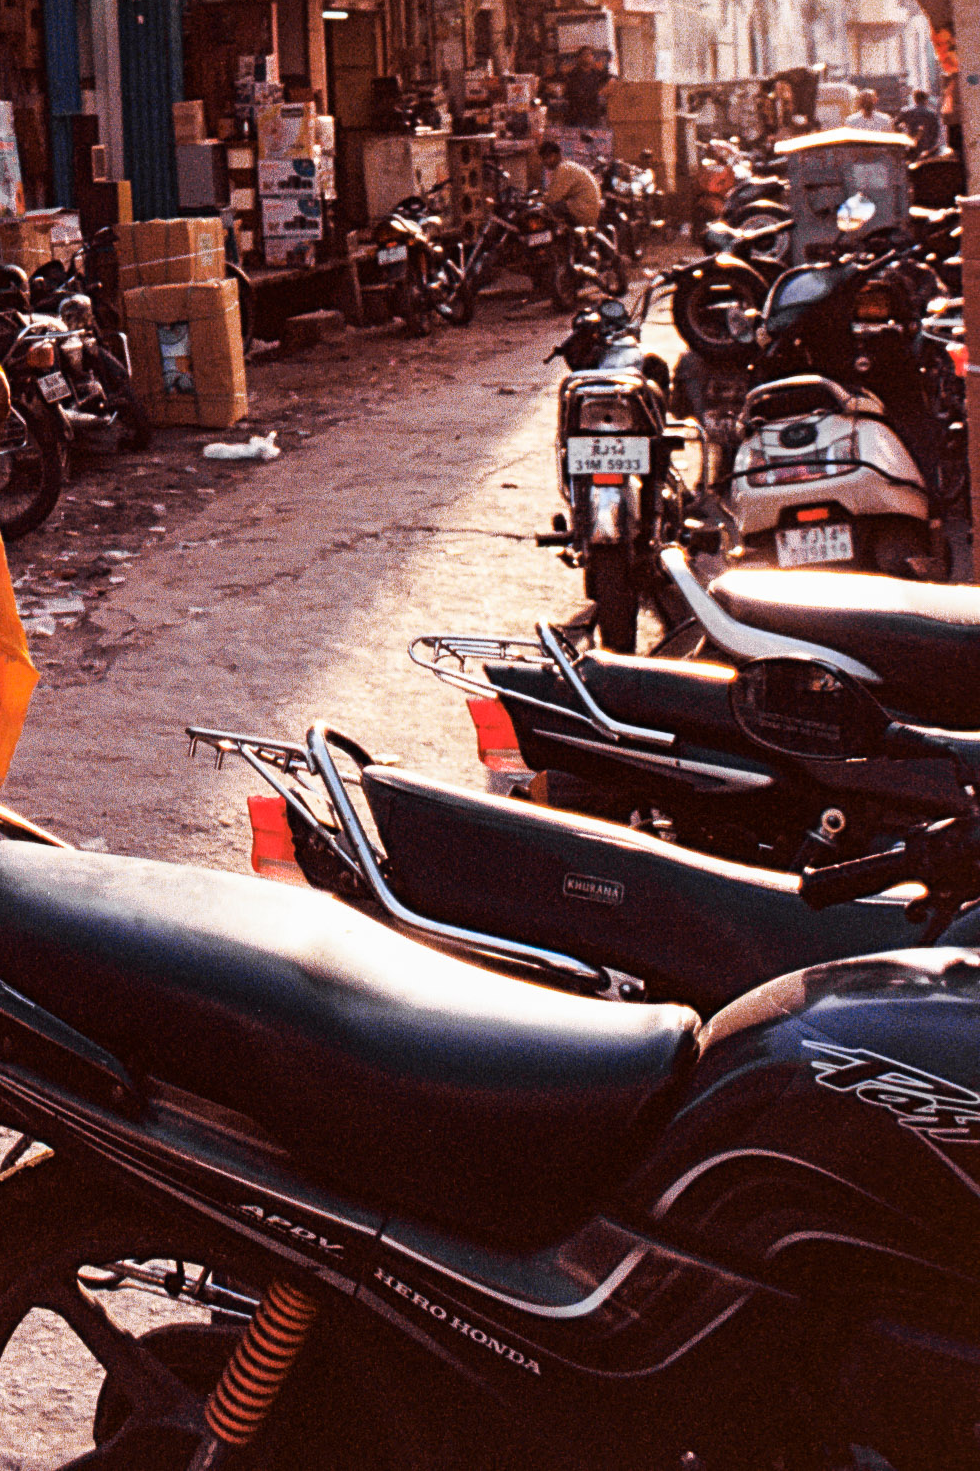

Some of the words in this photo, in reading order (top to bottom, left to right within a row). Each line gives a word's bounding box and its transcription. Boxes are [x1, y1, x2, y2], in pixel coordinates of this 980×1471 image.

[607, 459, 641, 471] 5933
[566, 878, 619, 898] KHURANA
[373, 1266, 448, 1321] HERO
[450, 1316, 542, 1377] HONDA
